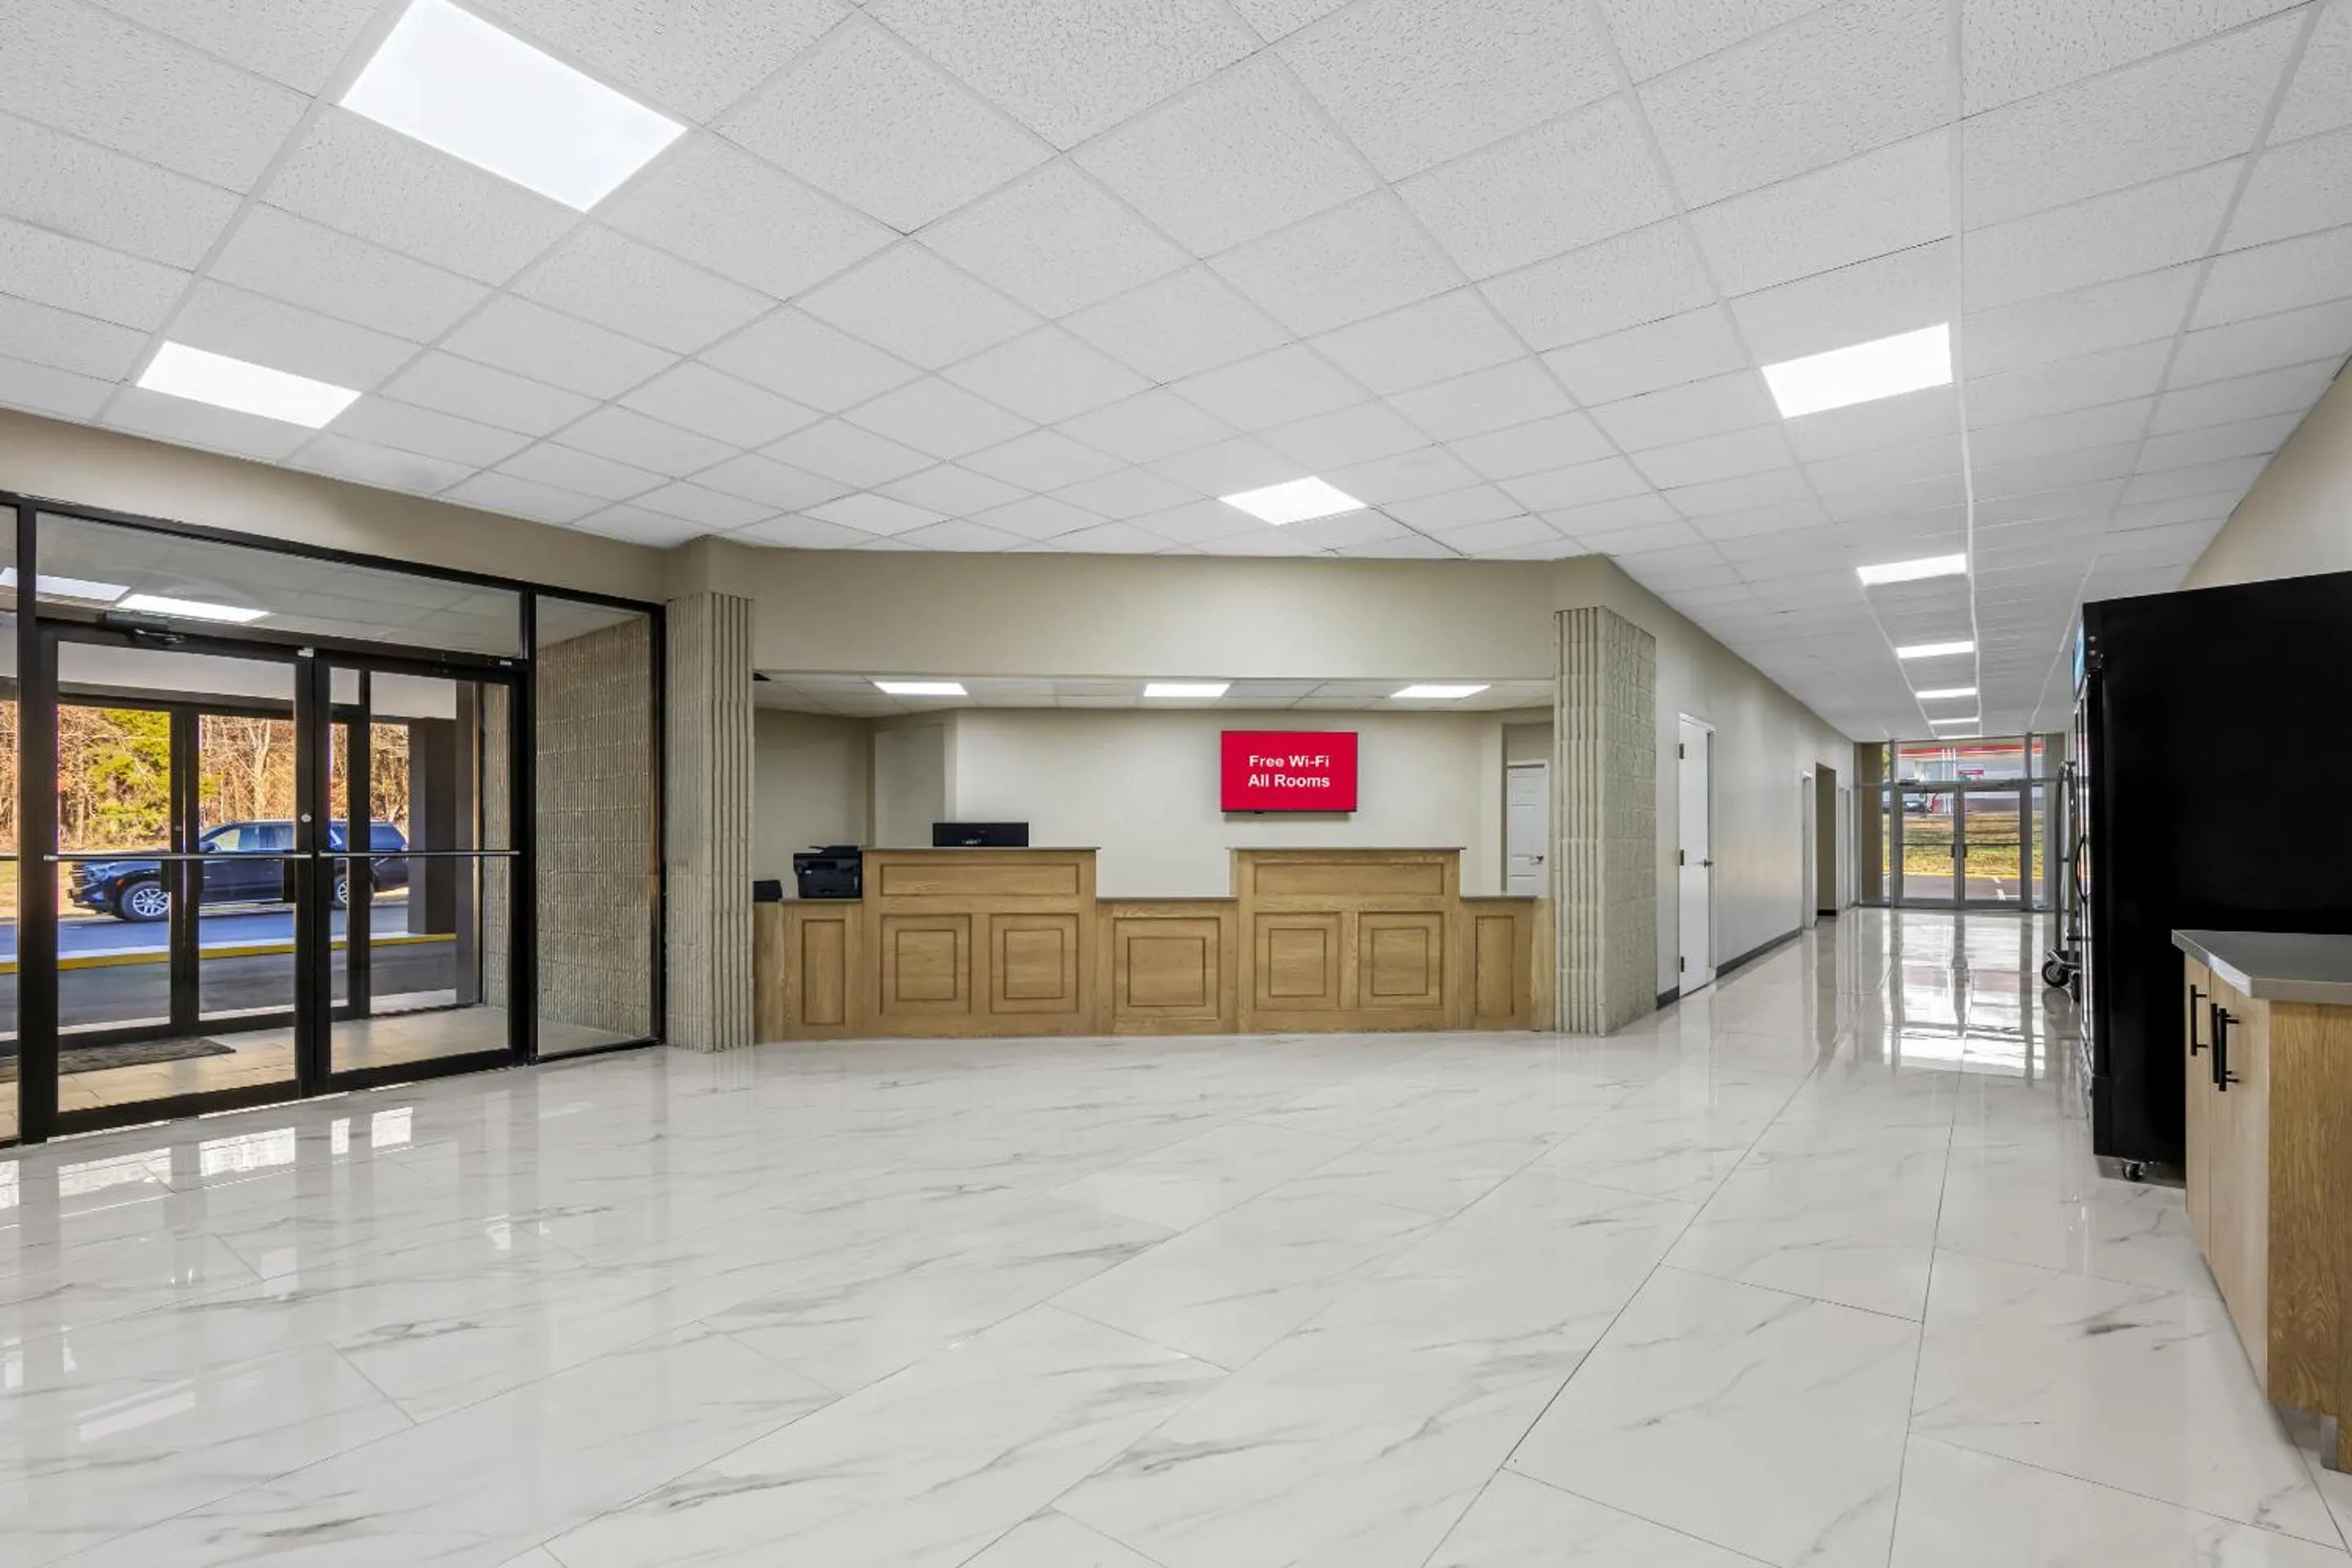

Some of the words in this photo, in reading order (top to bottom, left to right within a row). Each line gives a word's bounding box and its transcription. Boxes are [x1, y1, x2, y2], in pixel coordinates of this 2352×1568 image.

[1249, 755, 1285, 767] Free
[1289, 755, 1330, 767] Wi-Fi
[1248, 773, 1269, 787] All
[1274, 773, 1330, 787] Rooms
